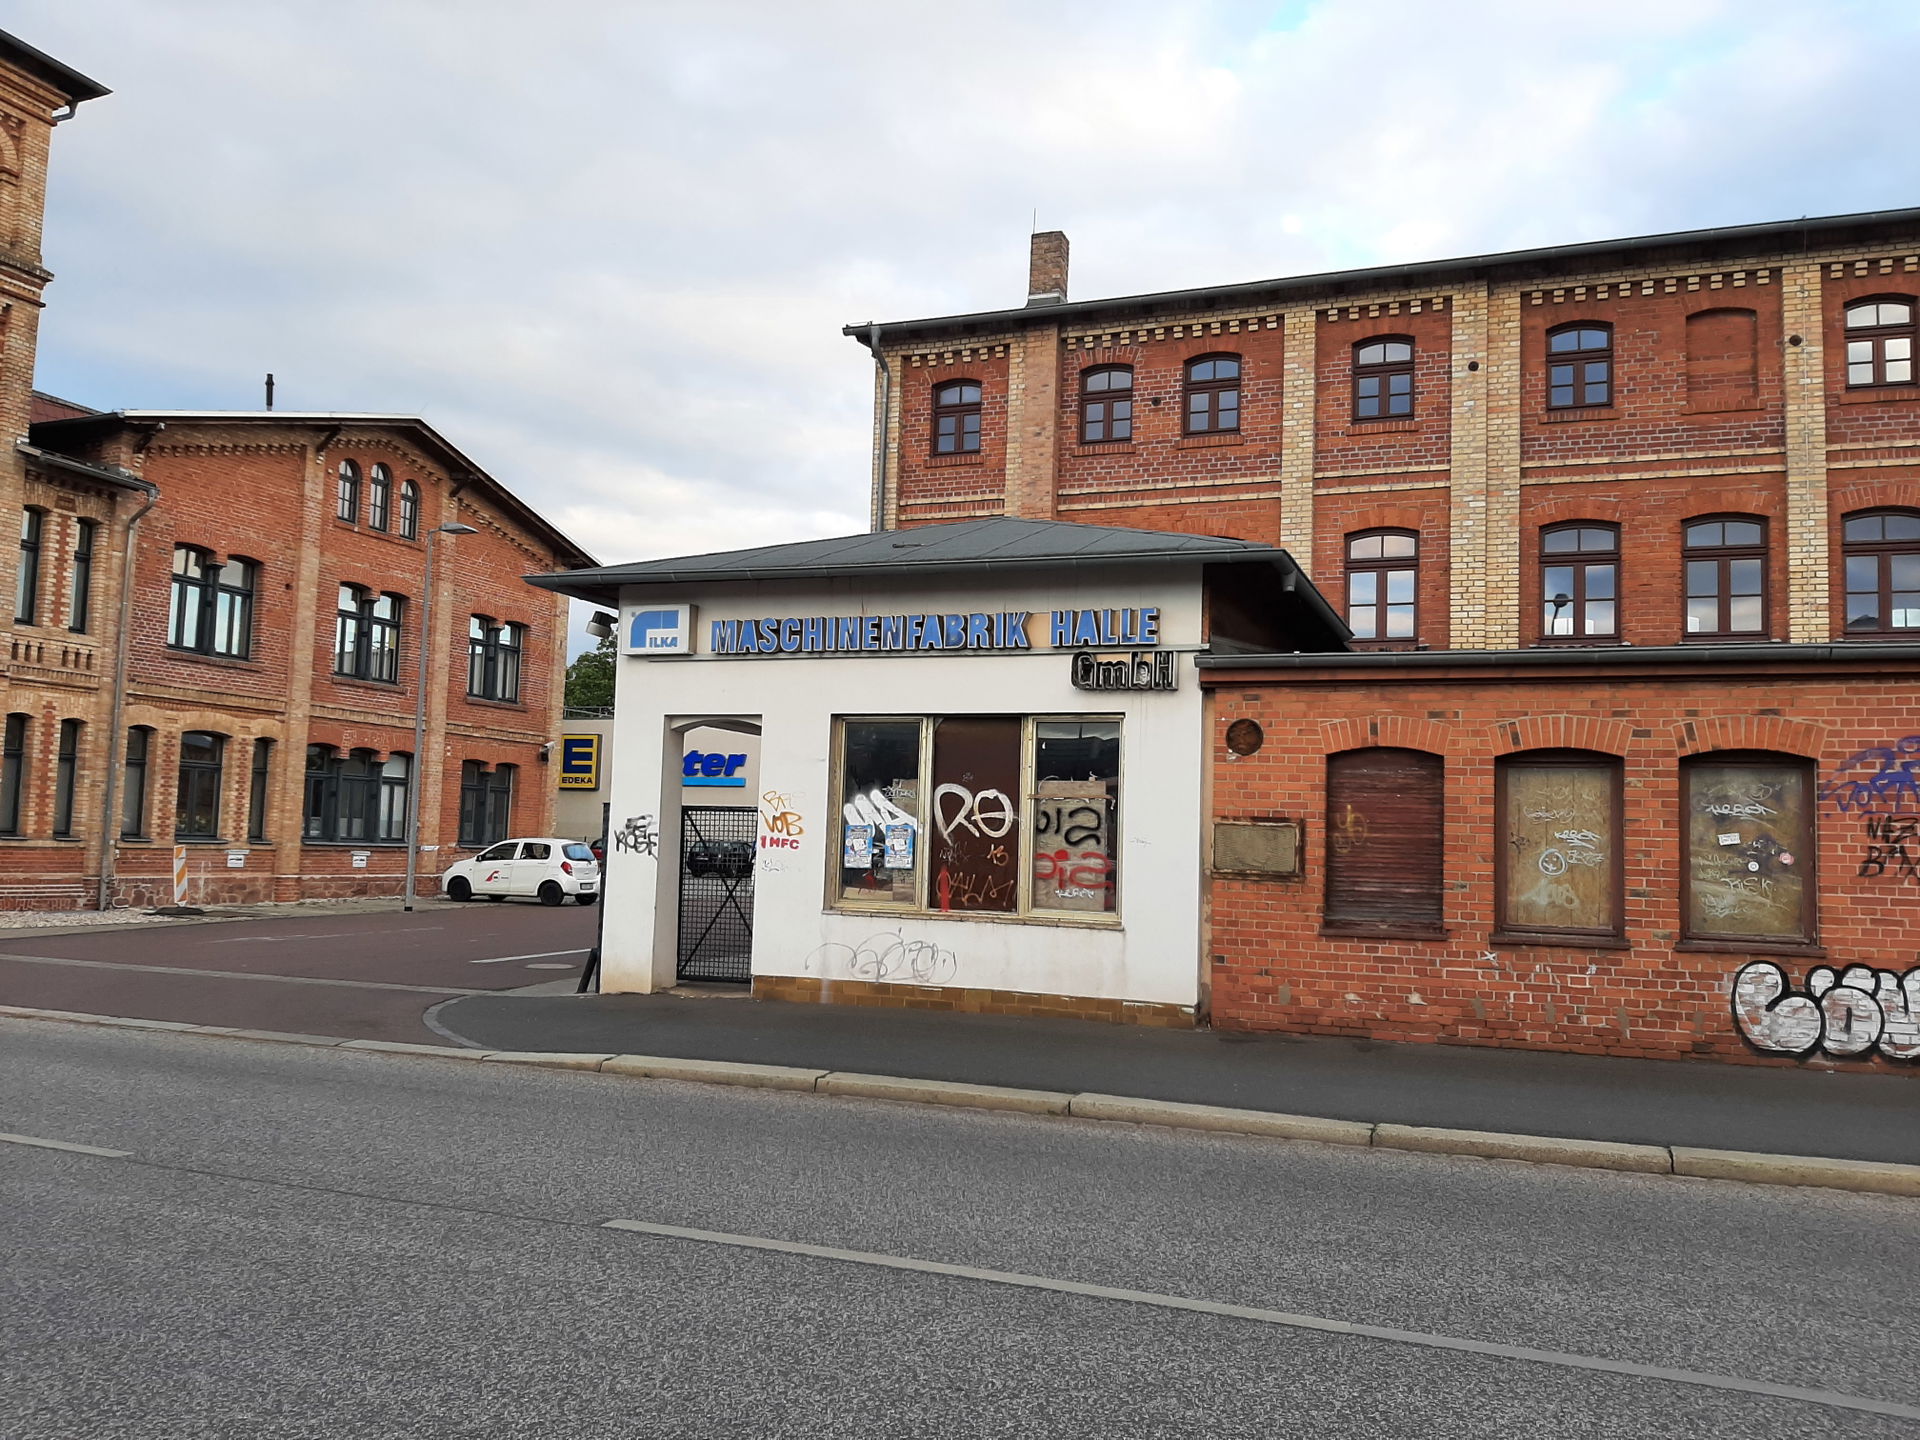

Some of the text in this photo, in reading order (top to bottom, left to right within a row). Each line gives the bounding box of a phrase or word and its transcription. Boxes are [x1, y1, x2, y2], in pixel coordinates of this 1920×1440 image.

[649, 636, 679, 649] ILKA
[711, 607, 1161, 654] MASCHINENFABRIK HALLE
[1070, 651, 1179, 691] GmbH
[562, 738, 594, 774] E
[682, 750, 748, 777] ter
[561, 776, 593, 785] EDEKA
